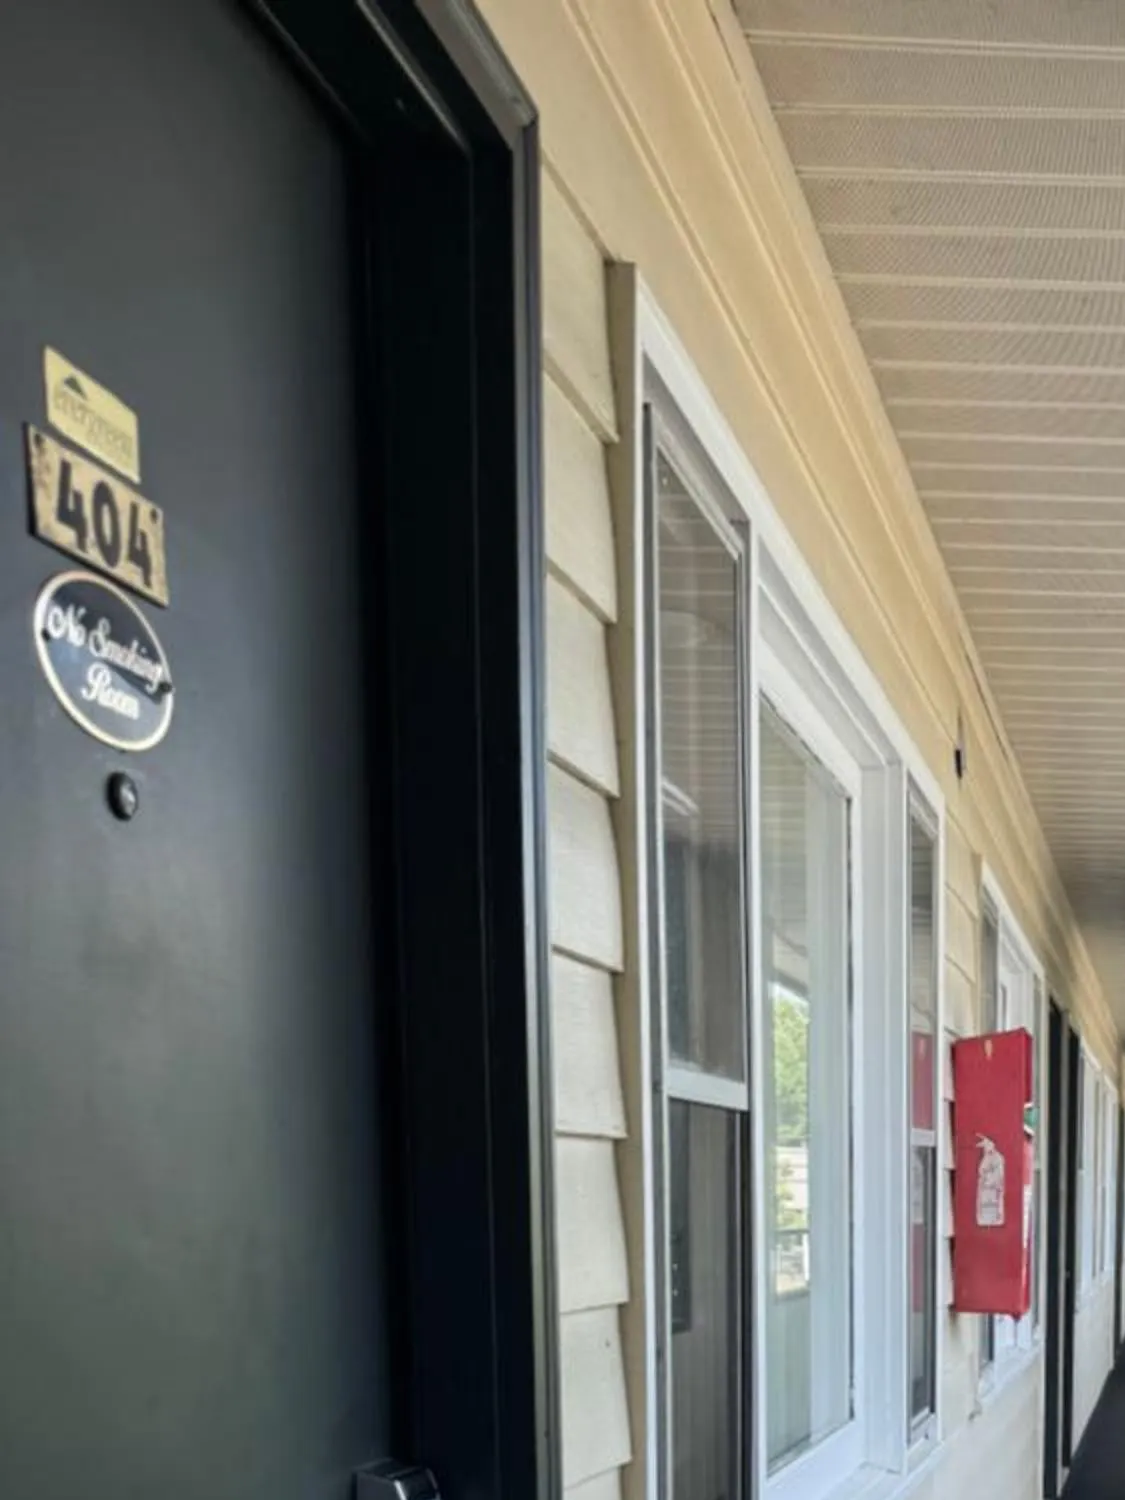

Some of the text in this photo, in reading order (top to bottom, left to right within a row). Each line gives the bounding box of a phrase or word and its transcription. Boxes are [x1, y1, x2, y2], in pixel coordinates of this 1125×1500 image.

[57, 458, 152, 588] 404
[47, 604, 163, 694] No Smoking
[81, 661, 139, 720] Room
